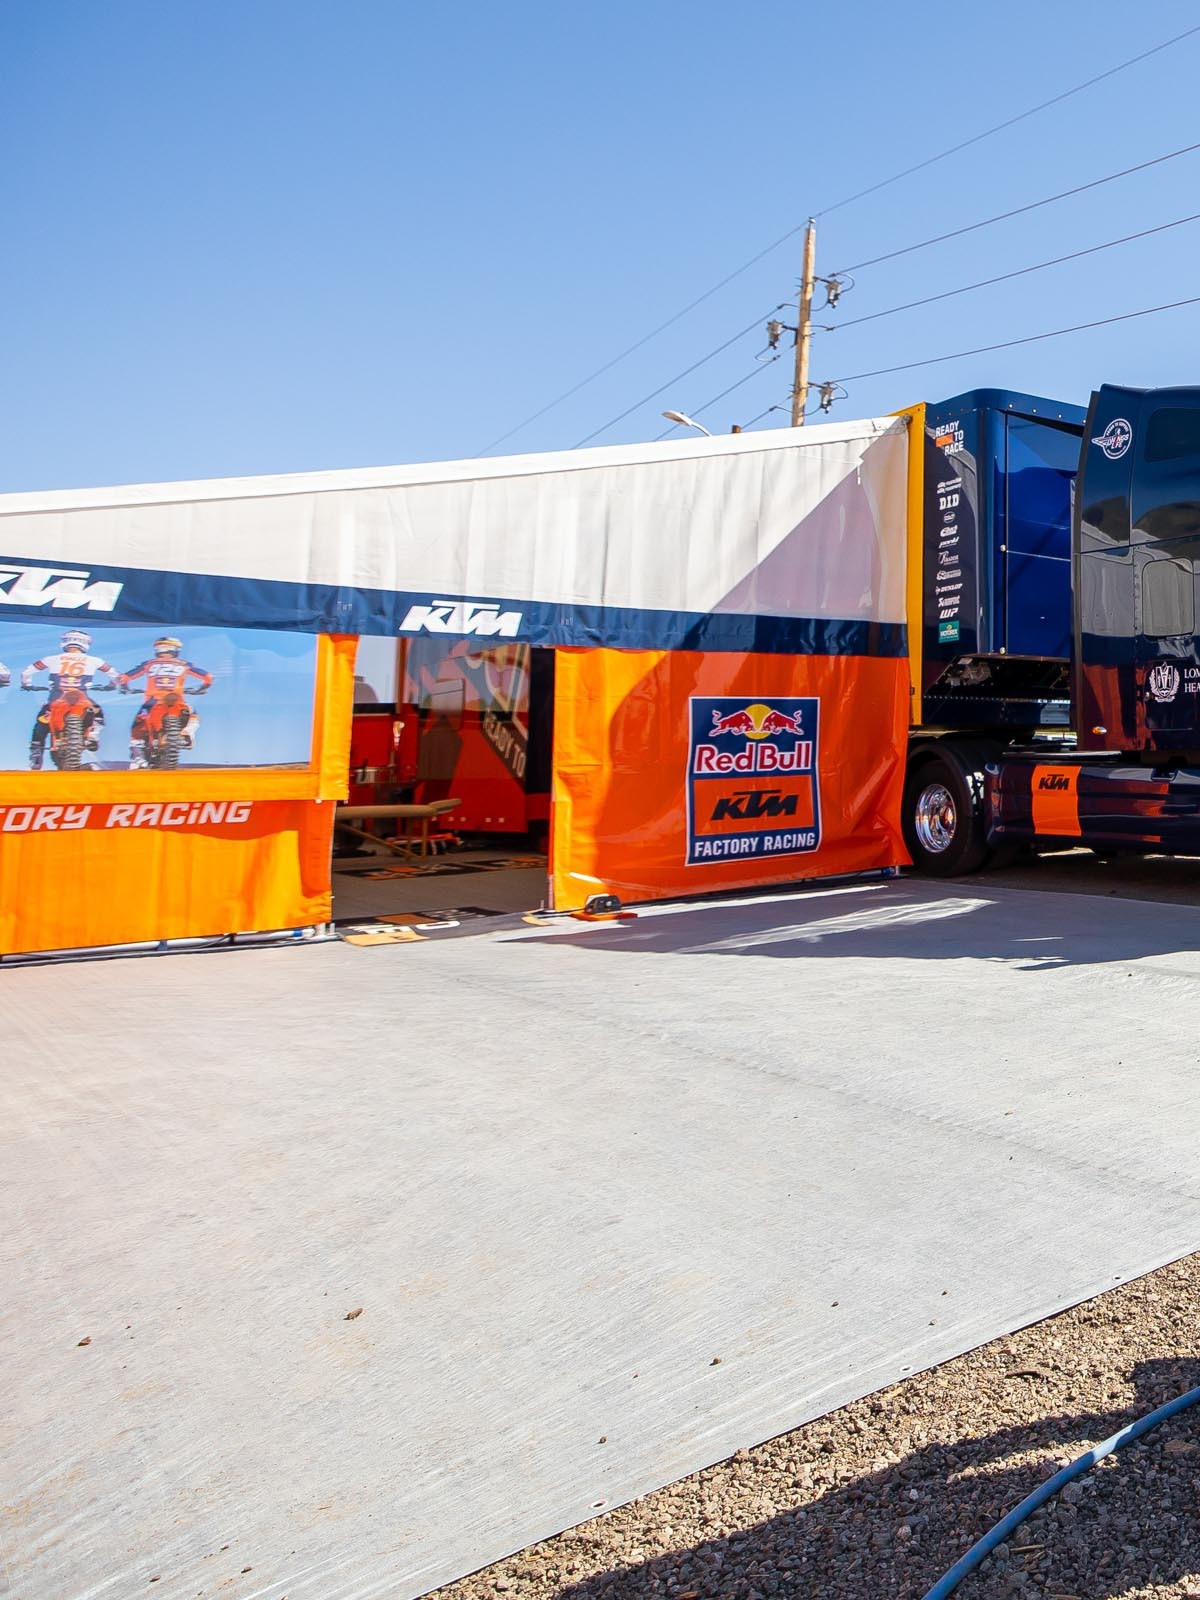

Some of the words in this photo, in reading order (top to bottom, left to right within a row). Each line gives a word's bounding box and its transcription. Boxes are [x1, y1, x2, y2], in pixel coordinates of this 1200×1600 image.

[936, 420, 960, 437] READY
[954, 430, 964, 441] TO
[944, 441, 964, 456] RACE
[939, 494, 960, 510] DID
[399, 600, 523, 637] KTM
[939, 607, 959, 619] WP
[60, 662, 84, 676] 16
[148, 663, 186, 677] 929
[1038, 774, 1070, 790] KTM
[710, 789, 799, 821] KTM
[0, 805, 92, 832] ORY
[694, 837, 759, 858] FACTORY
[764, 832, 816, 851] RACING
